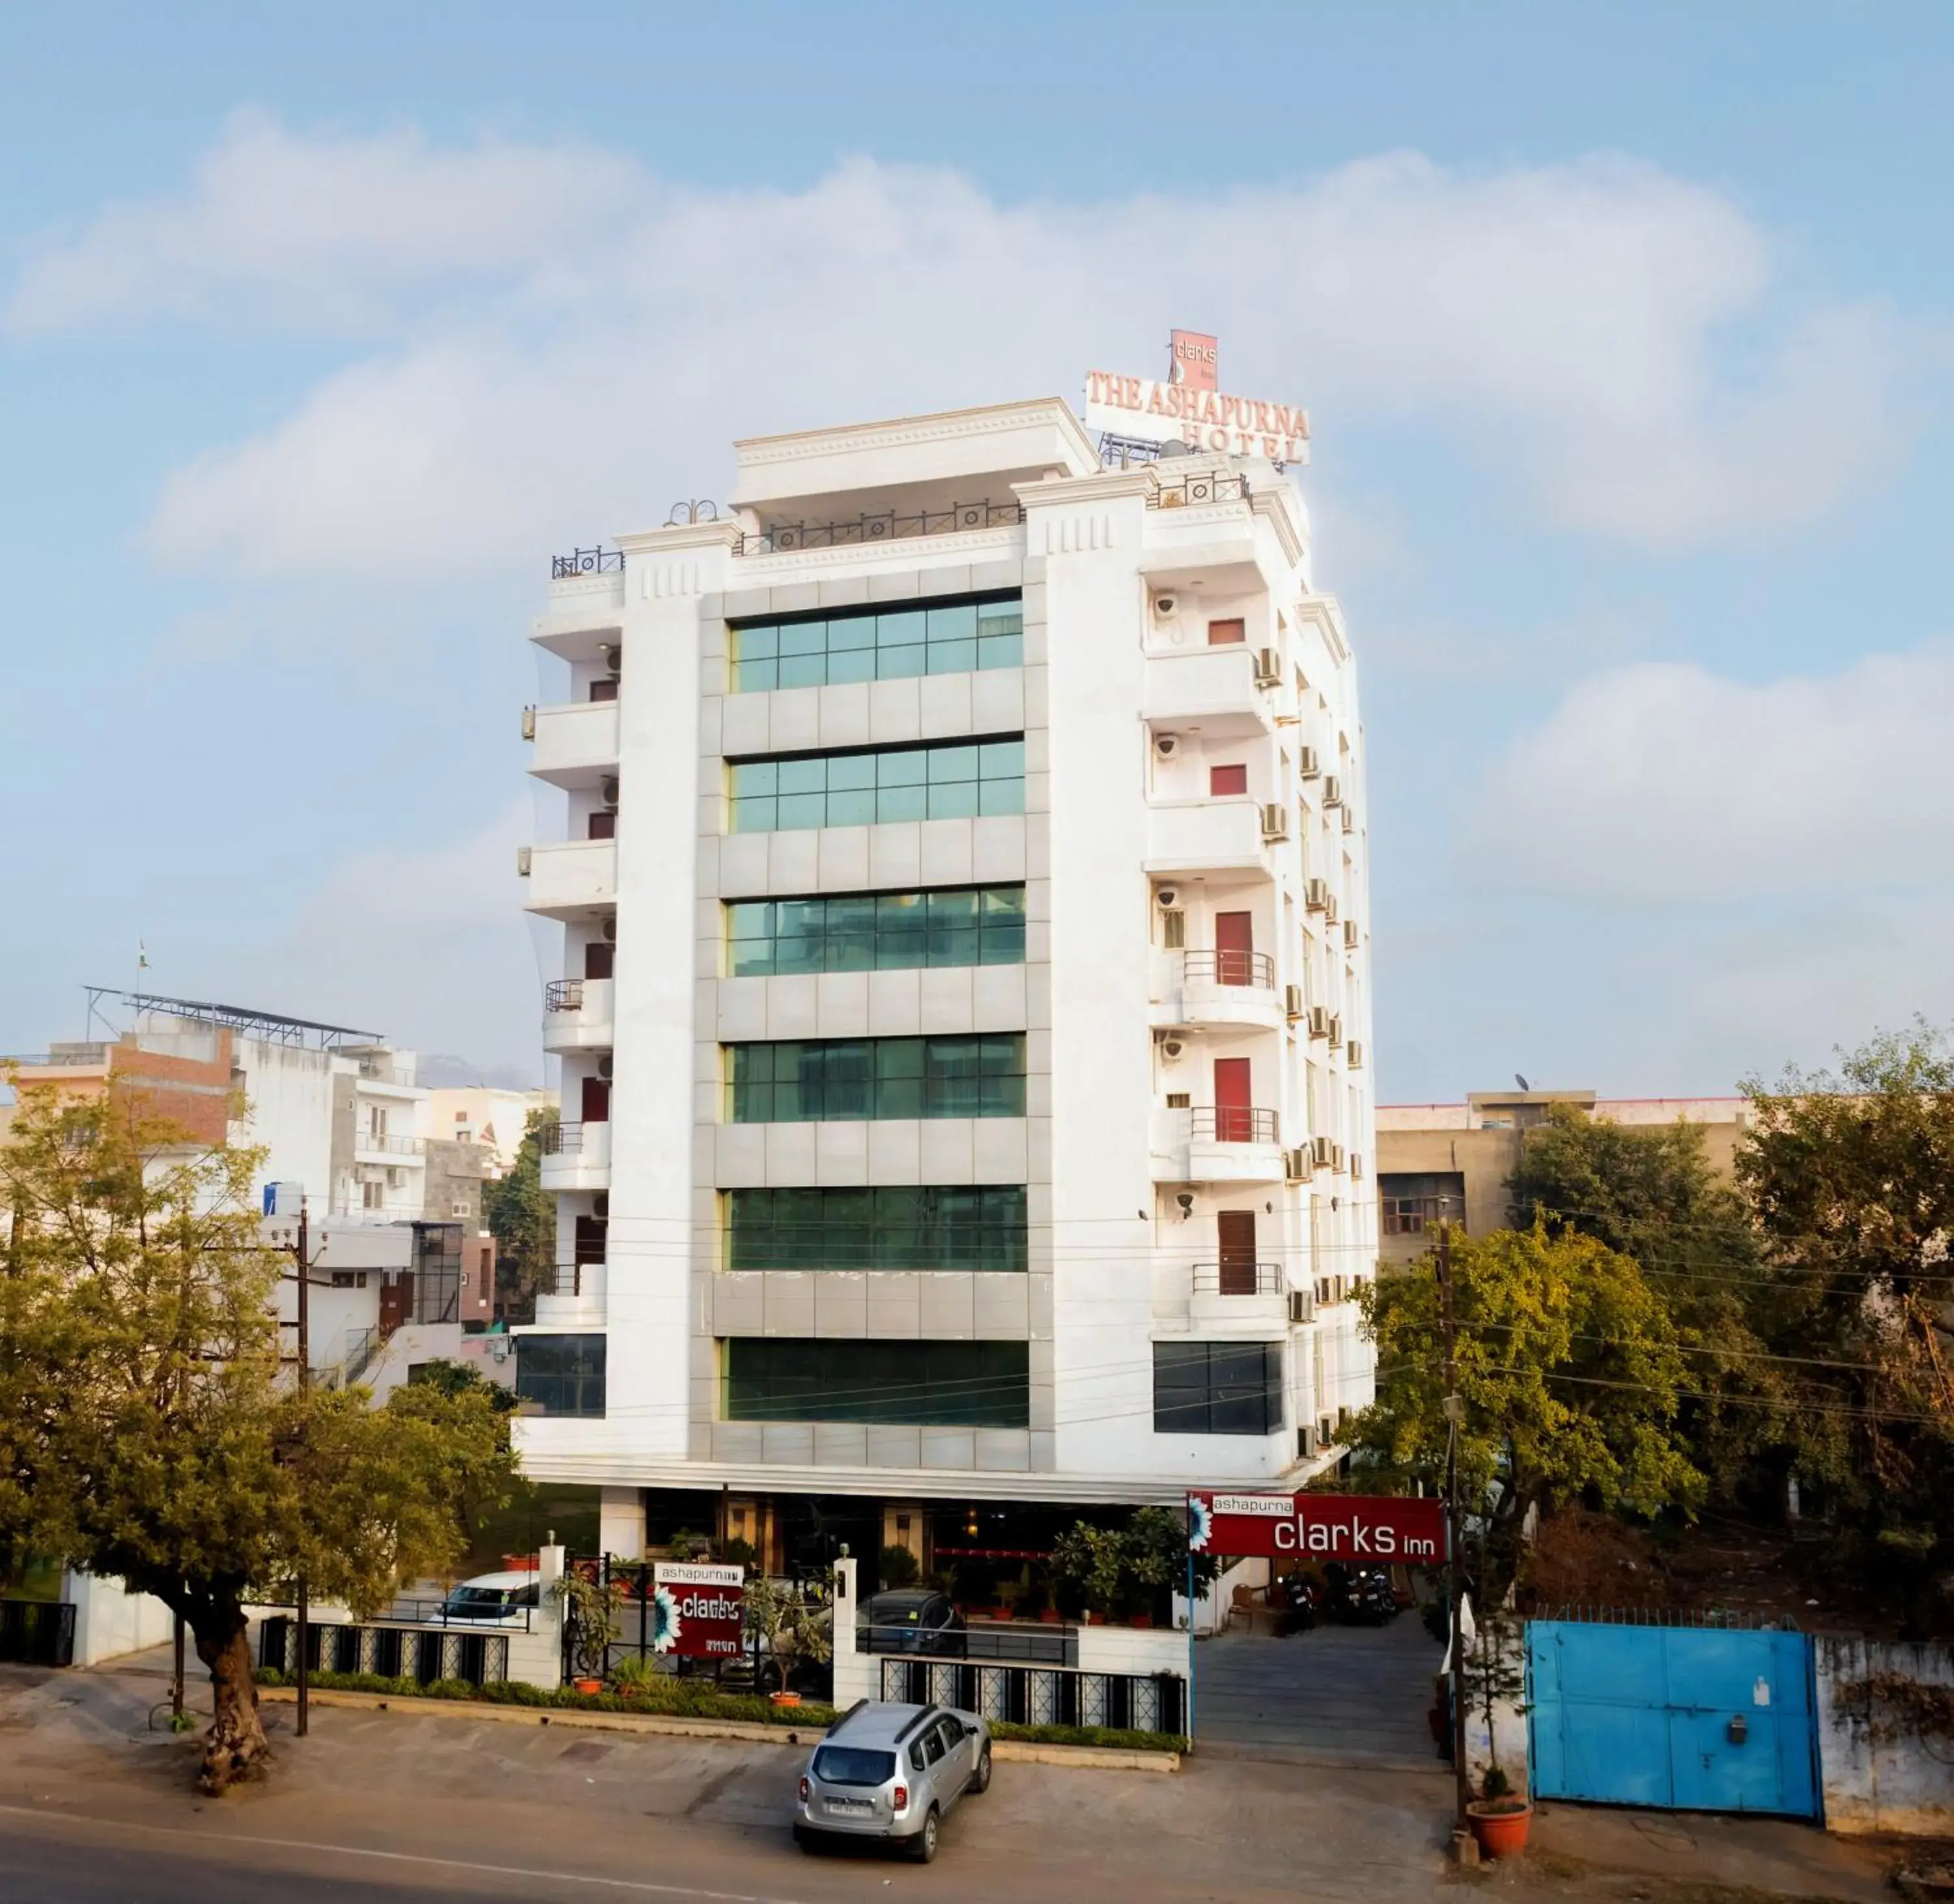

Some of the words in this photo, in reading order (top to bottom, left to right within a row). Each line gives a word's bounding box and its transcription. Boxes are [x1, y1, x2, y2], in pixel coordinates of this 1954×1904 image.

[1176, 339, 1216, 364] clarks
[1085, 369, 1142, 410] THE
[1148, 382, 1310, 440] ASHAPURNA
[1182, 423, 1305, 464] HOTEL
[1214, 1498, 1293, 1513] ashapurna
[1275, 1514, 1395, 1554] clarks
[1404, 1535, 1434, 1555] inn
